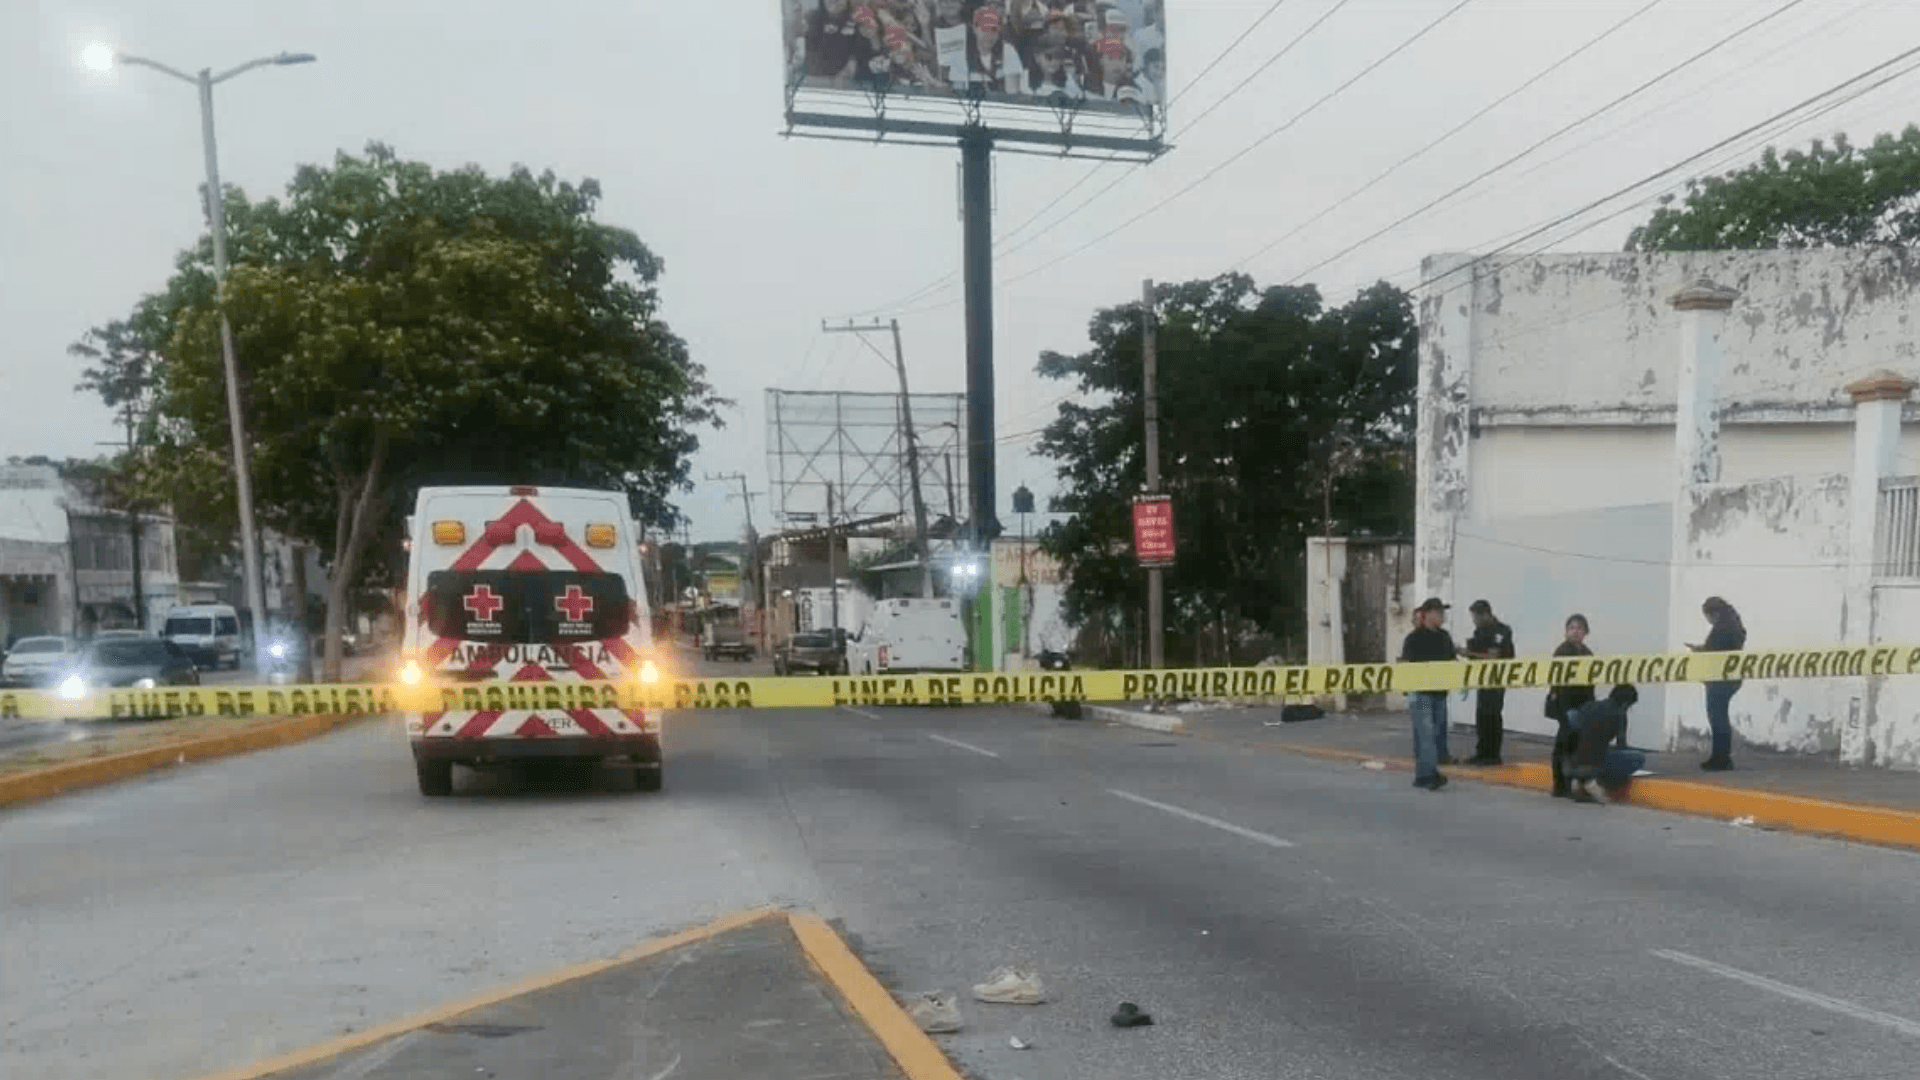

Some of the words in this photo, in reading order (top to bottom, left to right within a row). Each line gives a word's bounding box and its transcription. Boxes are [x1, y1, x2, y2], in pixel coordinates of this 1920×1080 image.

[1463, 661, 1538, 686] LINEA
[1547, 660, 1580, 685] DE
[1587, 656, 1690, 684] POLICIA
[1723, 648, 1866, 679] PROHIBIDO
[832, 678, 919, 705] LINEA
[928, 677, 962, 705] DE
[972, 674, 1088, 703] POLICIA
[1123, 669, 1277, 698] PROHIBIDO
[1284, 670, 1315, 694] EL
[1323, 666, 1394, 693] PASO
